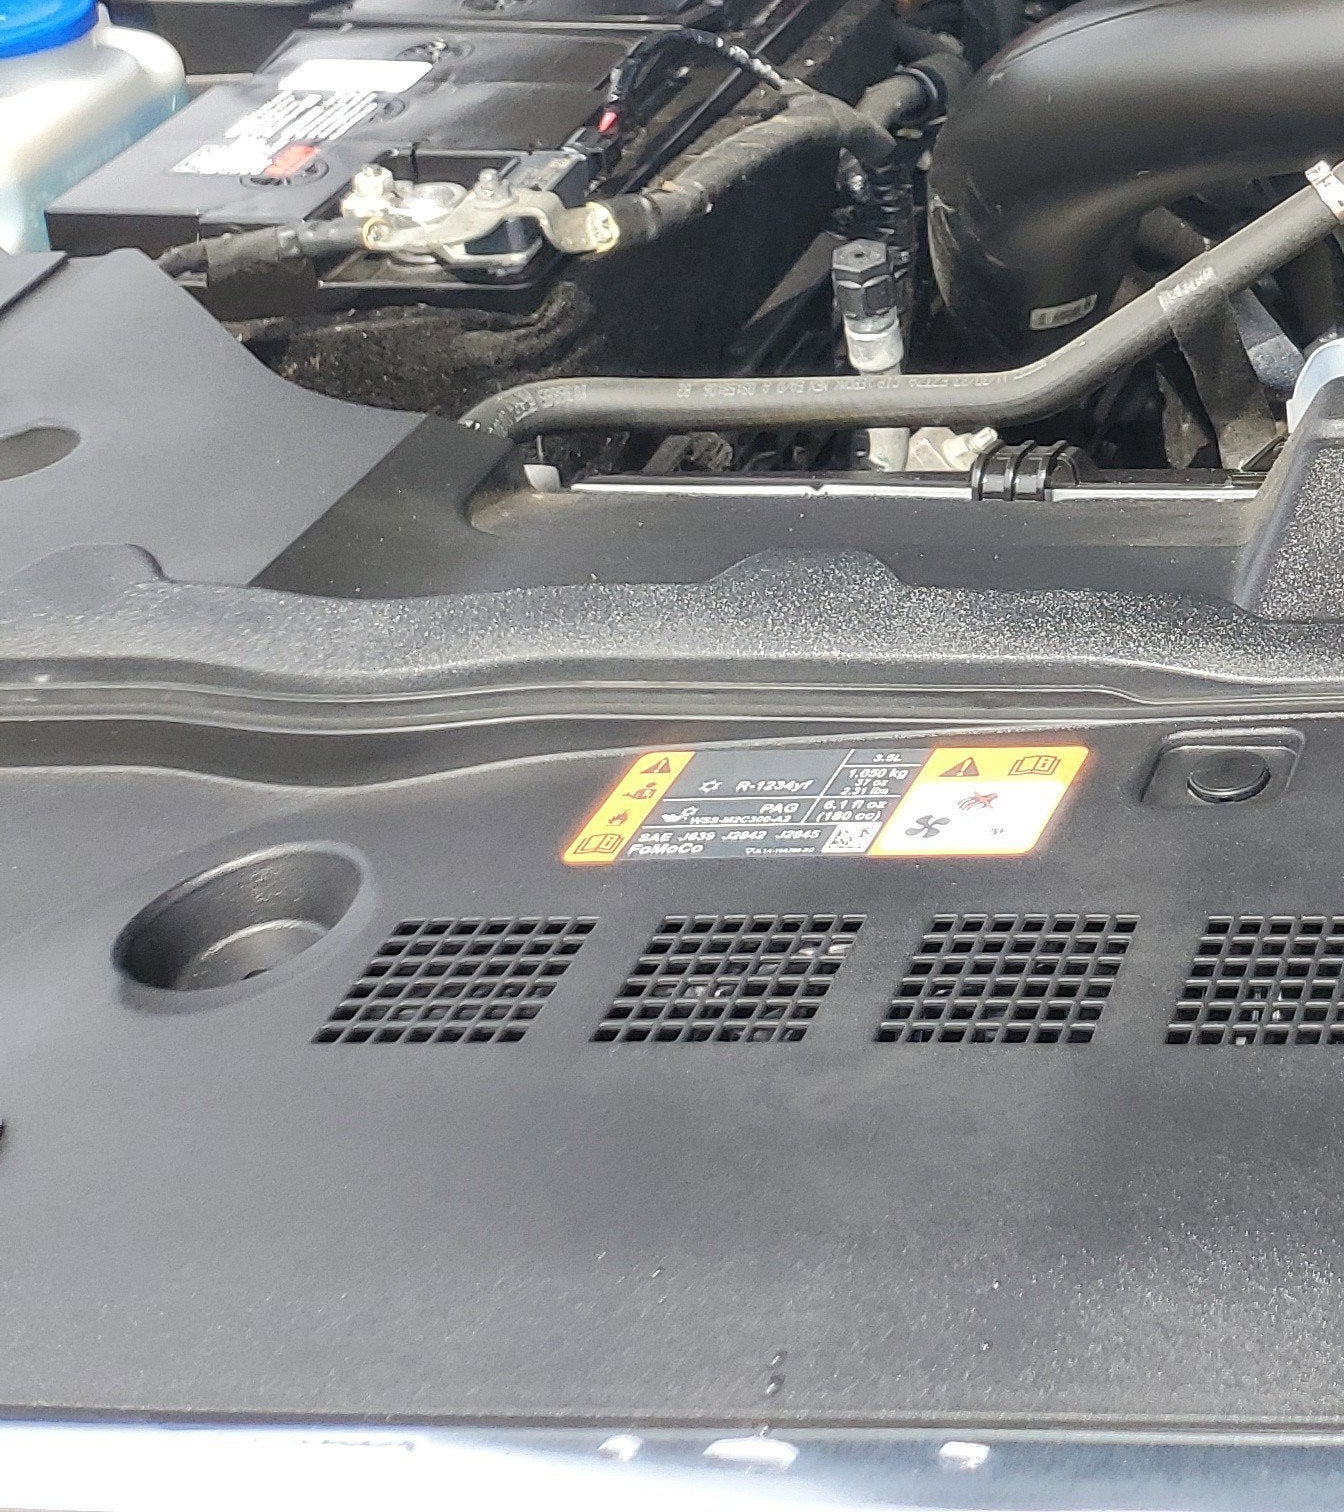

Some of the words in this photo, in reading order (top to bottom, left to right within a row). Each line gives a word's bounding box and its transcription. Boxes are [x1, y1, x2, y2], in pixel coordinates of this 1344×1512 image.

[872, 753, 902, 763] 3.5L
[849, 768, 888, 779] 1.050
[888, 768, 909, 780] kg
[736, 780, 814, 792] R-1234yf
[872, 779, 889, 787] oz
[760, 803, 799, 814] PAG
[866, 800, 888, 809] oz
[637, 832, 673, 843] SAE
[678, 831, 716, 842] J639
[628, 843, 704, 855] FoMoCo
